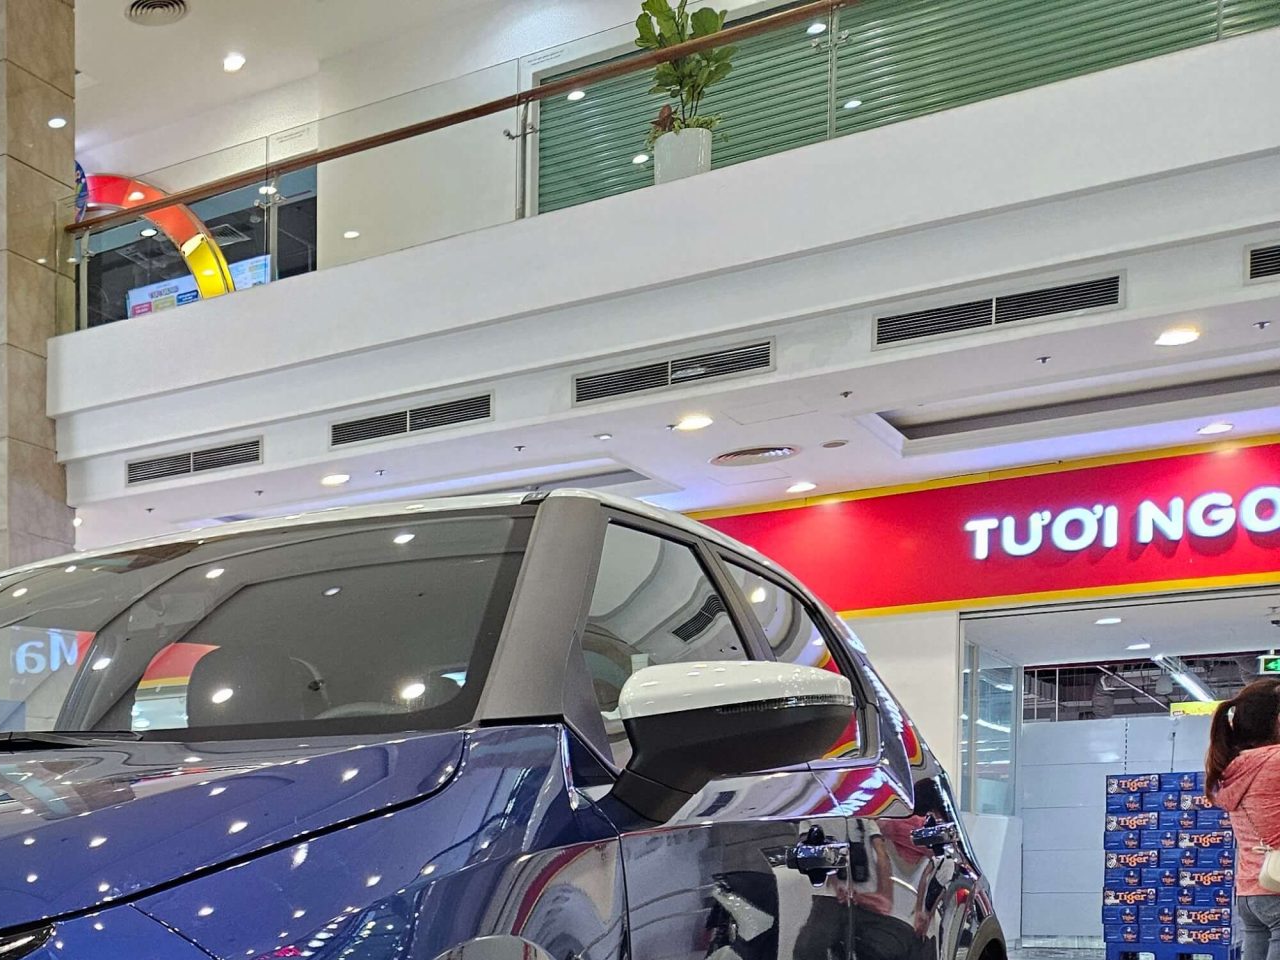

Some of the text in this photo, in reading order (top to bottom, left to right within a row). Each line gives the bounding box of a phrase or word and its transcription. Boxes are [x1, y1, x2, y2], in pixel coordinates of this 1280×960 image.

[964, 503, 1119, 560] TƯƠI
[1120, 778, 1150, 791] Tiger
[1119, 815, 1149, 829] Tiger
[1191, 833, 1222, 847] Tiger
[1119, 852, 1149, 867] Tiger
[1193, 871, 1223, 885] Tiger
[1116, 890, 1147, 904] Tiger
[1190, 909, 1221, 924] Tiger
[1190, 928, 1221, 943] Tiger
